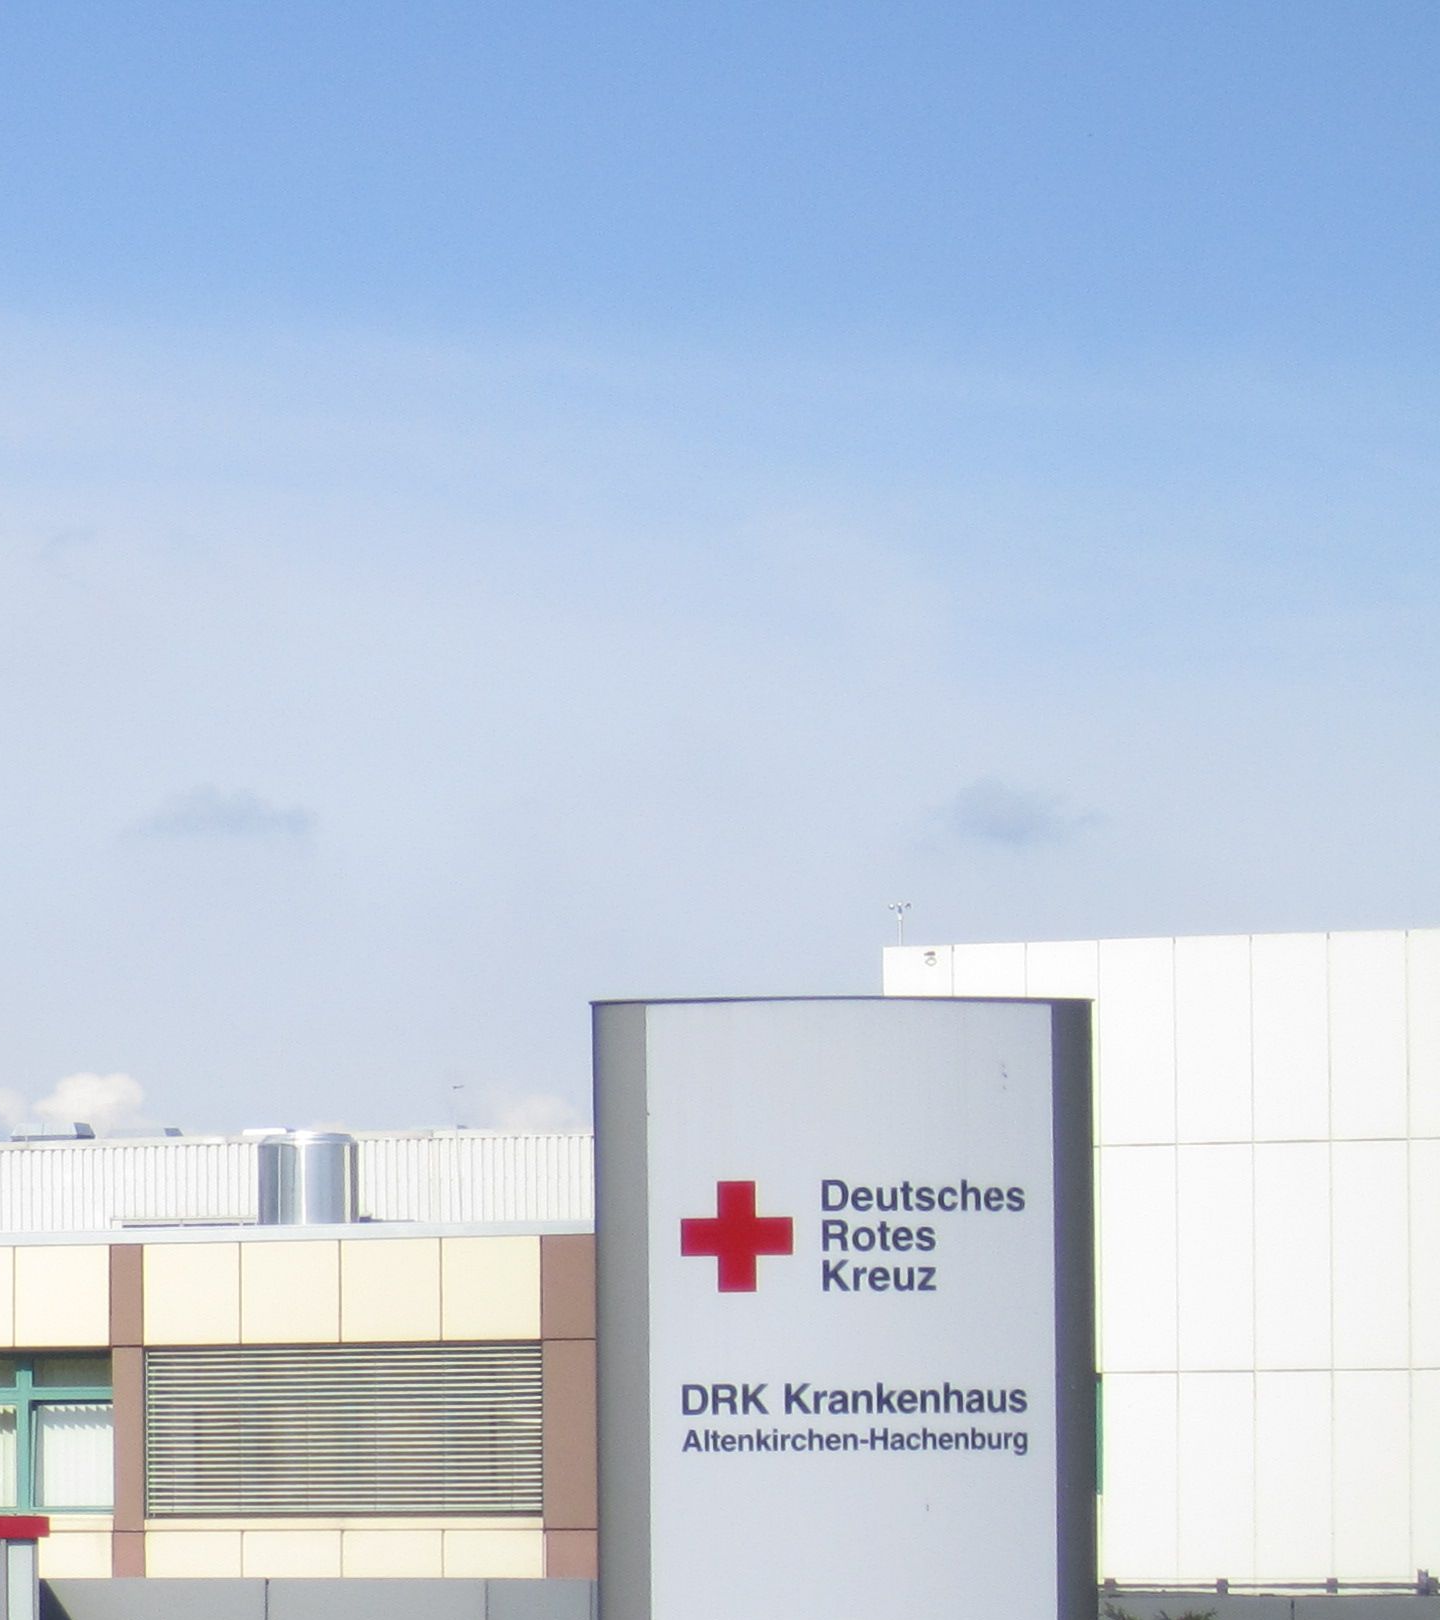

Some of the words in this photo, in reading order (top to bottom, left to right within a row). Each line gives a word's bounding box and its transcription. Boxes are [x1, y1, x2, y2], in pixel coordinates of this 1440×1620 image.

[821, 1178, 1026, 1212] Deutsches
[821, 1219, 937, 1252] Rotes
[821, 1259, 938, 1292] Kreuz
[681, 1383, 769, 1416] DRK
[784, 1381, 1028, 1415] Krankenhaus
[681, 1427, 1028, 1456] Altenkirchen-Hachenburg
